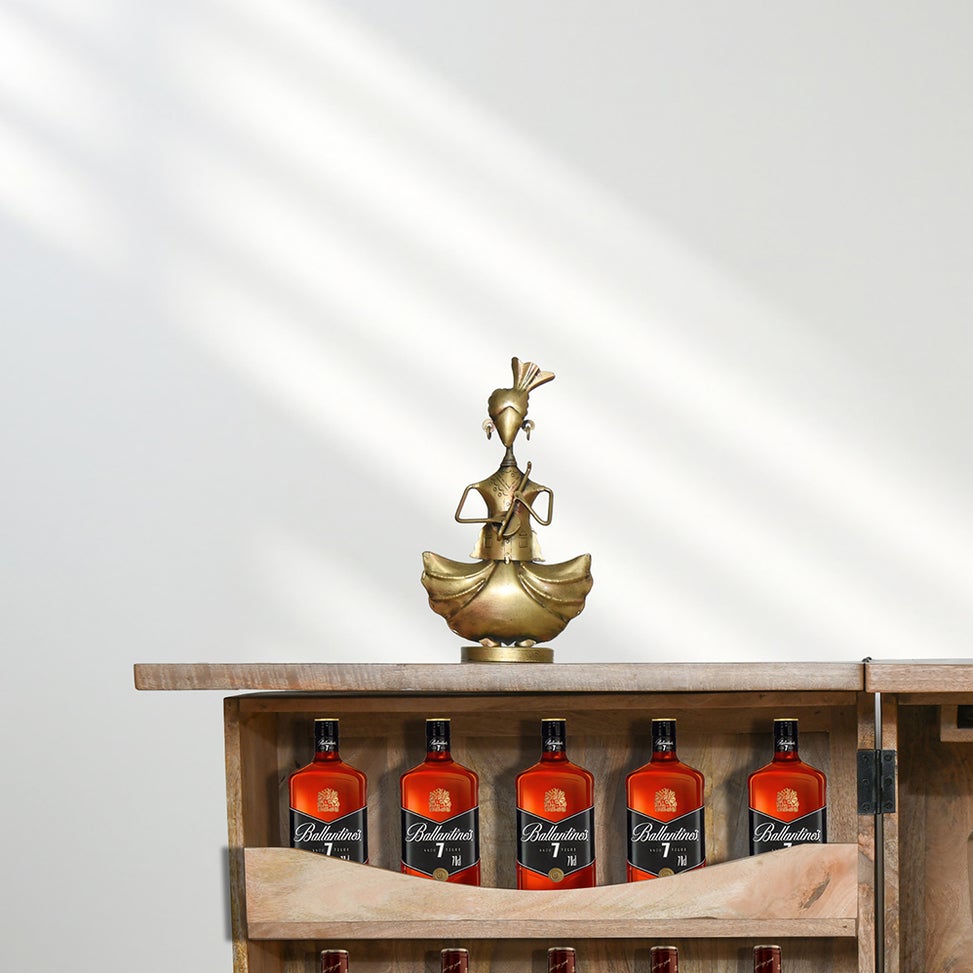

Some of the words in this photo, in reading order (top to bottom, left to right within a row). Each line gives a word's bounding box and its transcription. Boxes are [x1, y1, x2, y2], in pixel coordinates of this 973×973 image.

[323, 842, 333, 856] 7
[435, 842, 445, 858] 7
[550, 842, 560, 858] 7
[661, 842, 671, 858] 7
